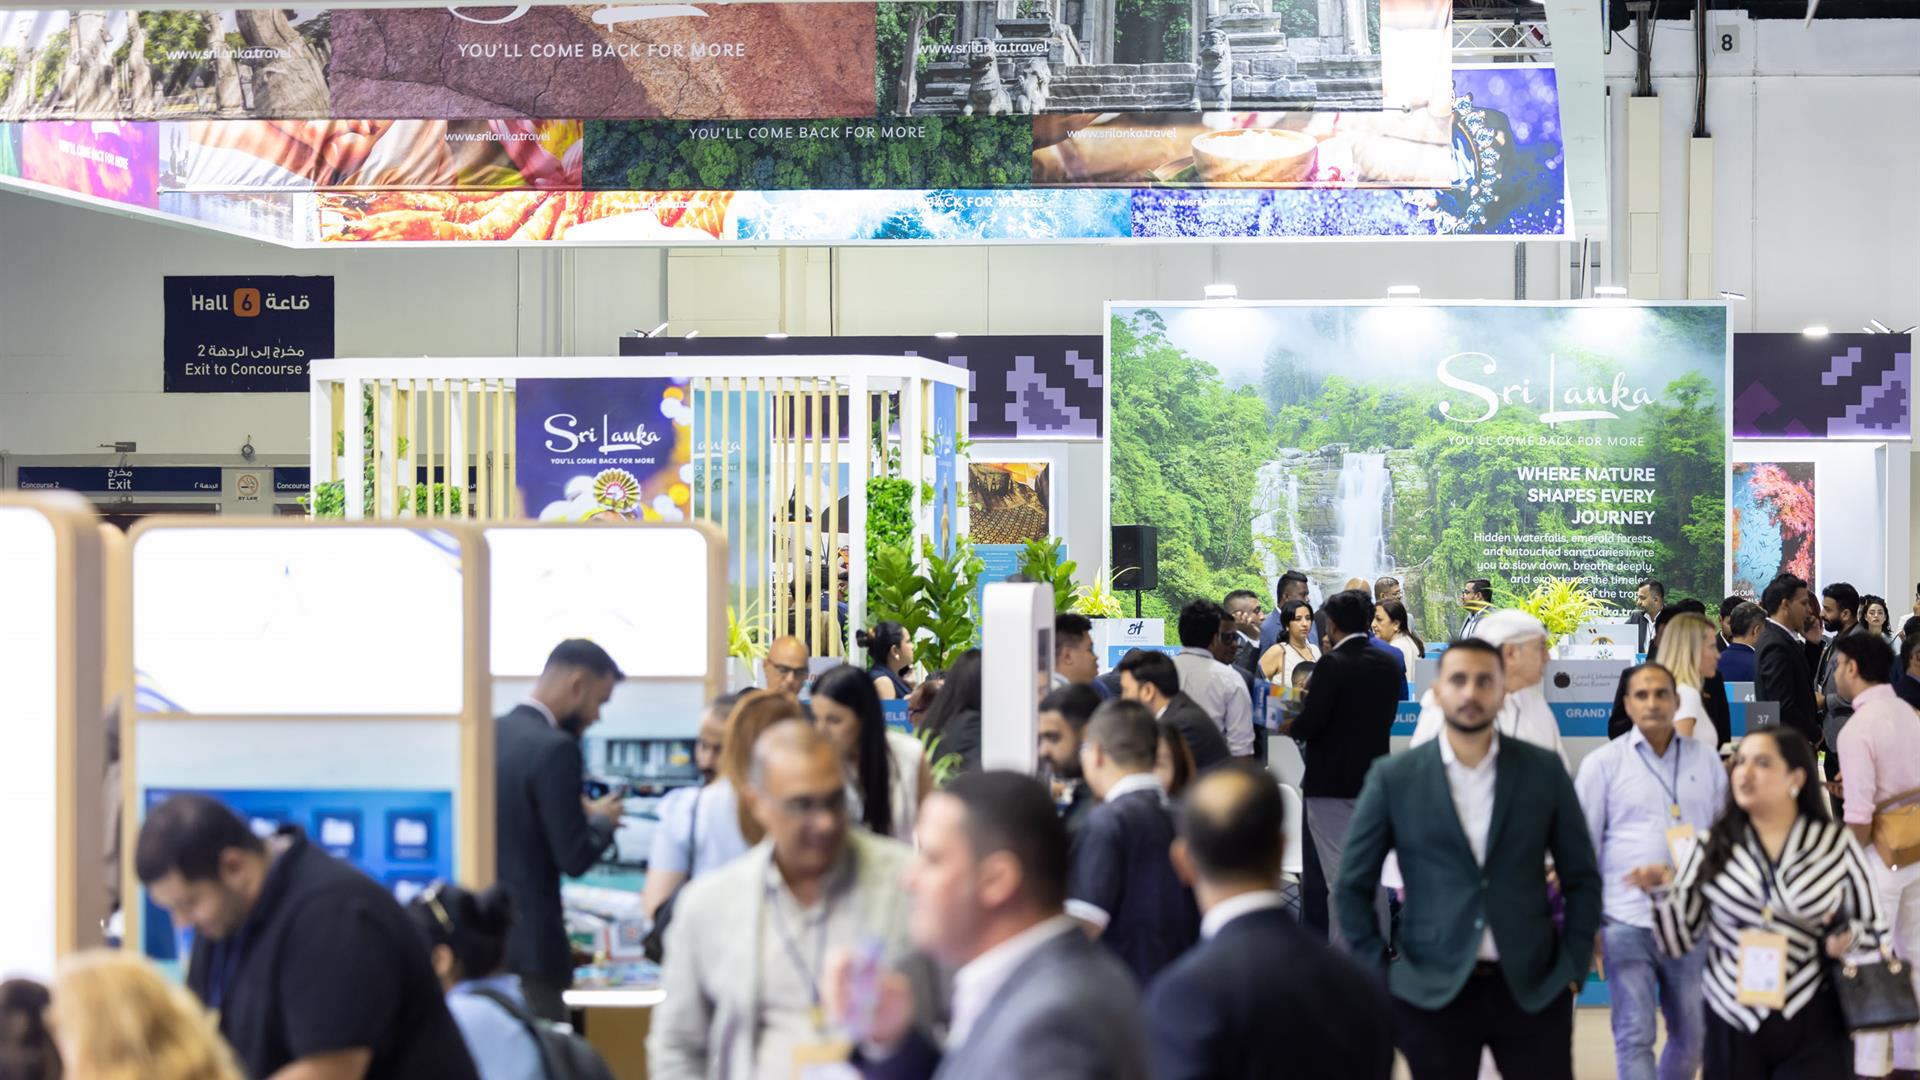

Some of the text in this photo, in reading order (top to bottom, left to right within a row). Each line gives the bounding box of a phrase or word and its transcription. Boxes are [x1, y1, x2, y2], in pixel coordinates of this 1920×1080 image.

[918, 40, 1049, 54] www.srilanka.travel
[1721, 34, 1733, 51] 8
[166, 47, 292, 60] www.srilanka.travel
[459, 43, 745, 57] YOU'LL COME BACK FOR MORE
[445, 130, 551, 142] www.srilanka.travel
[689, 126, 926, 139] YOU'LL COME BACK FOR MORE
[1066, 127, 1177, 138] www.srilanka.travel
[967, 196, 993, 208] FOR
[192, 293, 253, 312] Hall 6
[265, 292, 310, 311] قاعة
[197, 344, 305, 360] مخرج إلى الردهة 2
[185, 362, 210, 376] Exit
[214, 363, 227, 376] to
[231, 363, 303, 376] Concourse
[1436, 351, 1657, 430] Sri Lanka
[543, 413, 662, 456] Sri Lanka
[1447, 435, 1645, 447] YOU'LL COME BACK FOR MORE
[576, 457, 597, 465] COME
[598, 457, 618, 465] BACK
[618, 457, 633, 465] FOR
[634, 457, 656, 465] MORE
[107, 468, 133, 478] مخرج
[1517, 466, 1656, 482] WHERE NATURE
[21, 481, 54, 489] Concourse
[107, 479, 132, 490] Exit
[276, 482, 310, 490] Concourse
[1527, 487, 1656, 503] SHAPES EVERY
[1571, 509, 1656, 525] JOURNEY
[1473, 532, 1655, 545] Hidden waterfalls, emerald forests,
[1482, 546, 1655, 558] and untouched sanctuaries invite
[1476, 560, 1655, 573] you to slow down, breathe deeply,
[1510, 574, 1531, 584] and
[1591, 574, 1608, 585] the
[1598, 588, 1617, 599] the
[1744, 694, 1755, 702] 41
[1565, 708, 1606, 719] GRAND
[1757, 714, 1770, 724] 37
